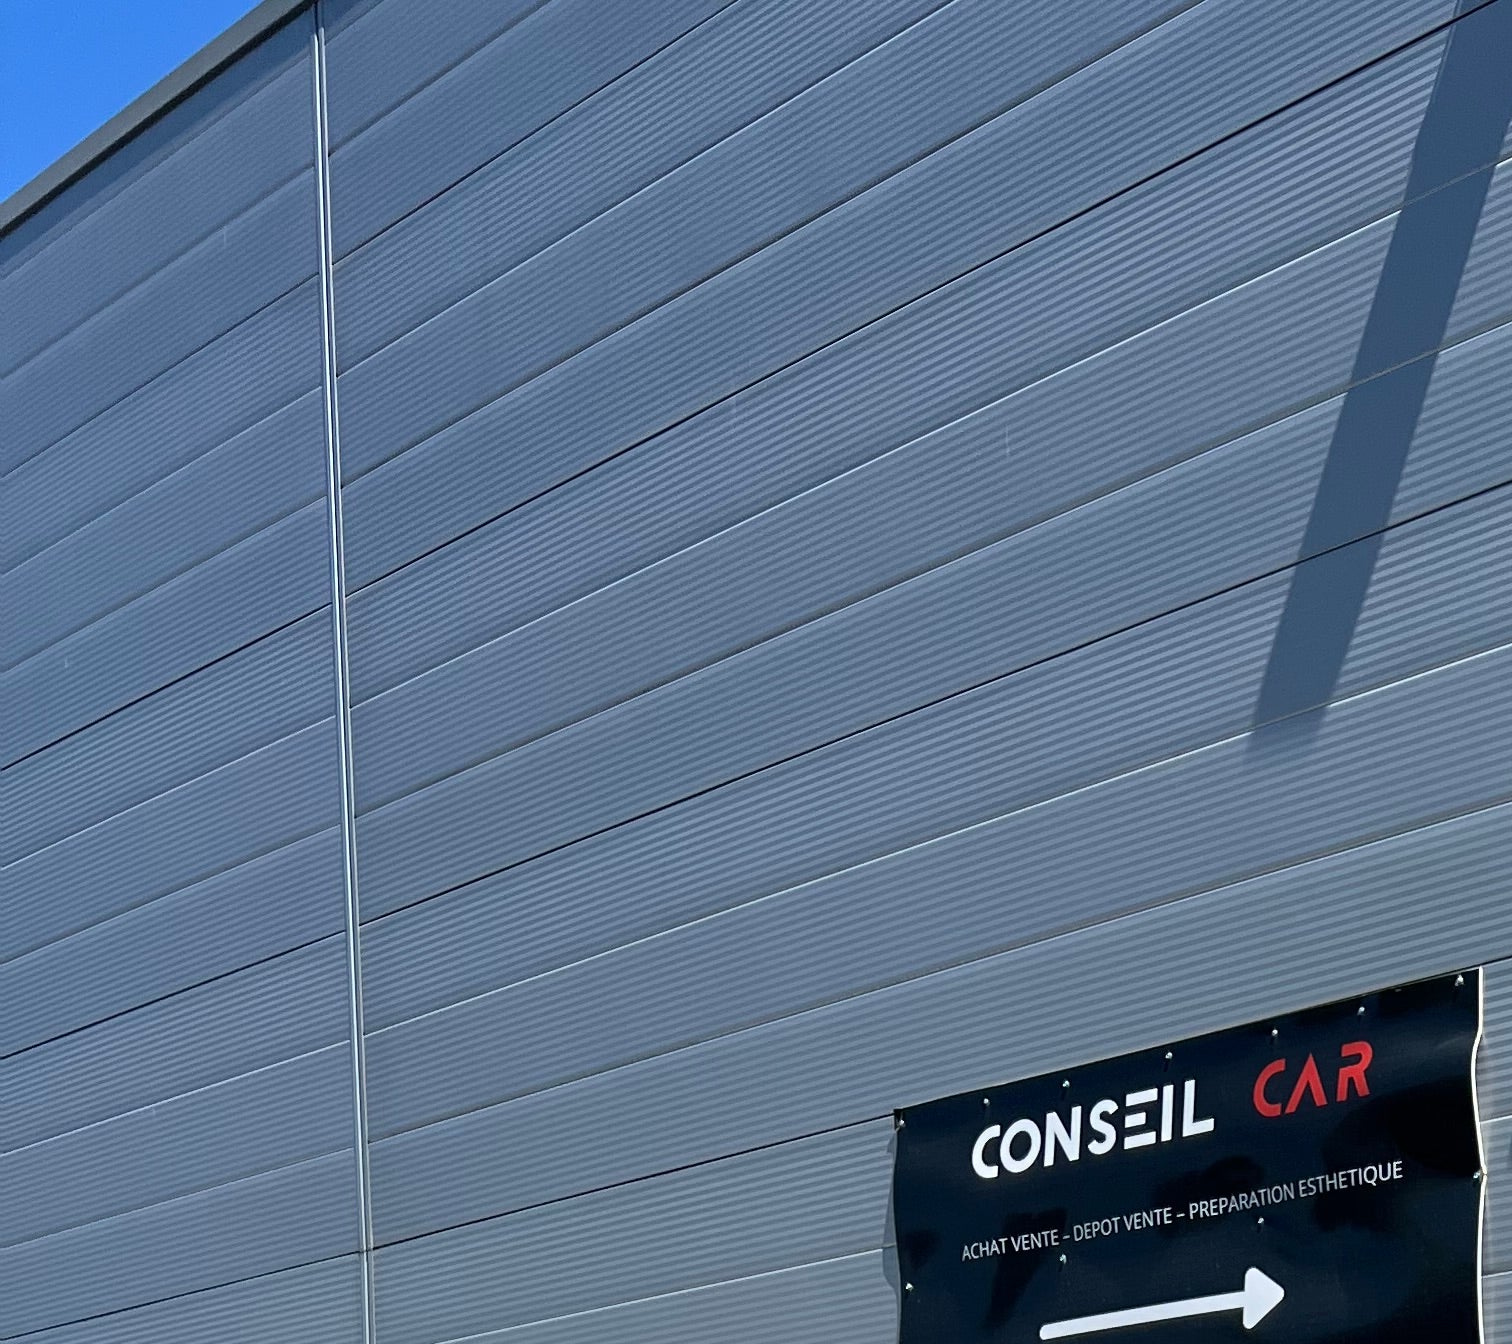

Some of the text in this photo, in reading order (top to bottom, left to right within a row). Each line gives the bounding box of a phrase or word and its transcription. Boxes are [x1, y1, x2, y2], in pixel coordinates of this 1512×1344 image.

[972, 1040, 1373, 1178] CONSEIL CAR
[962, 1237, 1008, 1261] ACHAT
[1011, 1229, 1059, 1252] VENTE
[1073, 1216, 1120, 1242] DEPOT
[1123, 1207, 1172, 1231] VENTE
[1189, 1182, 1295, 1219] PREPARATION
[1299, 1160, 1403, 1198] ESTHETIQUE
